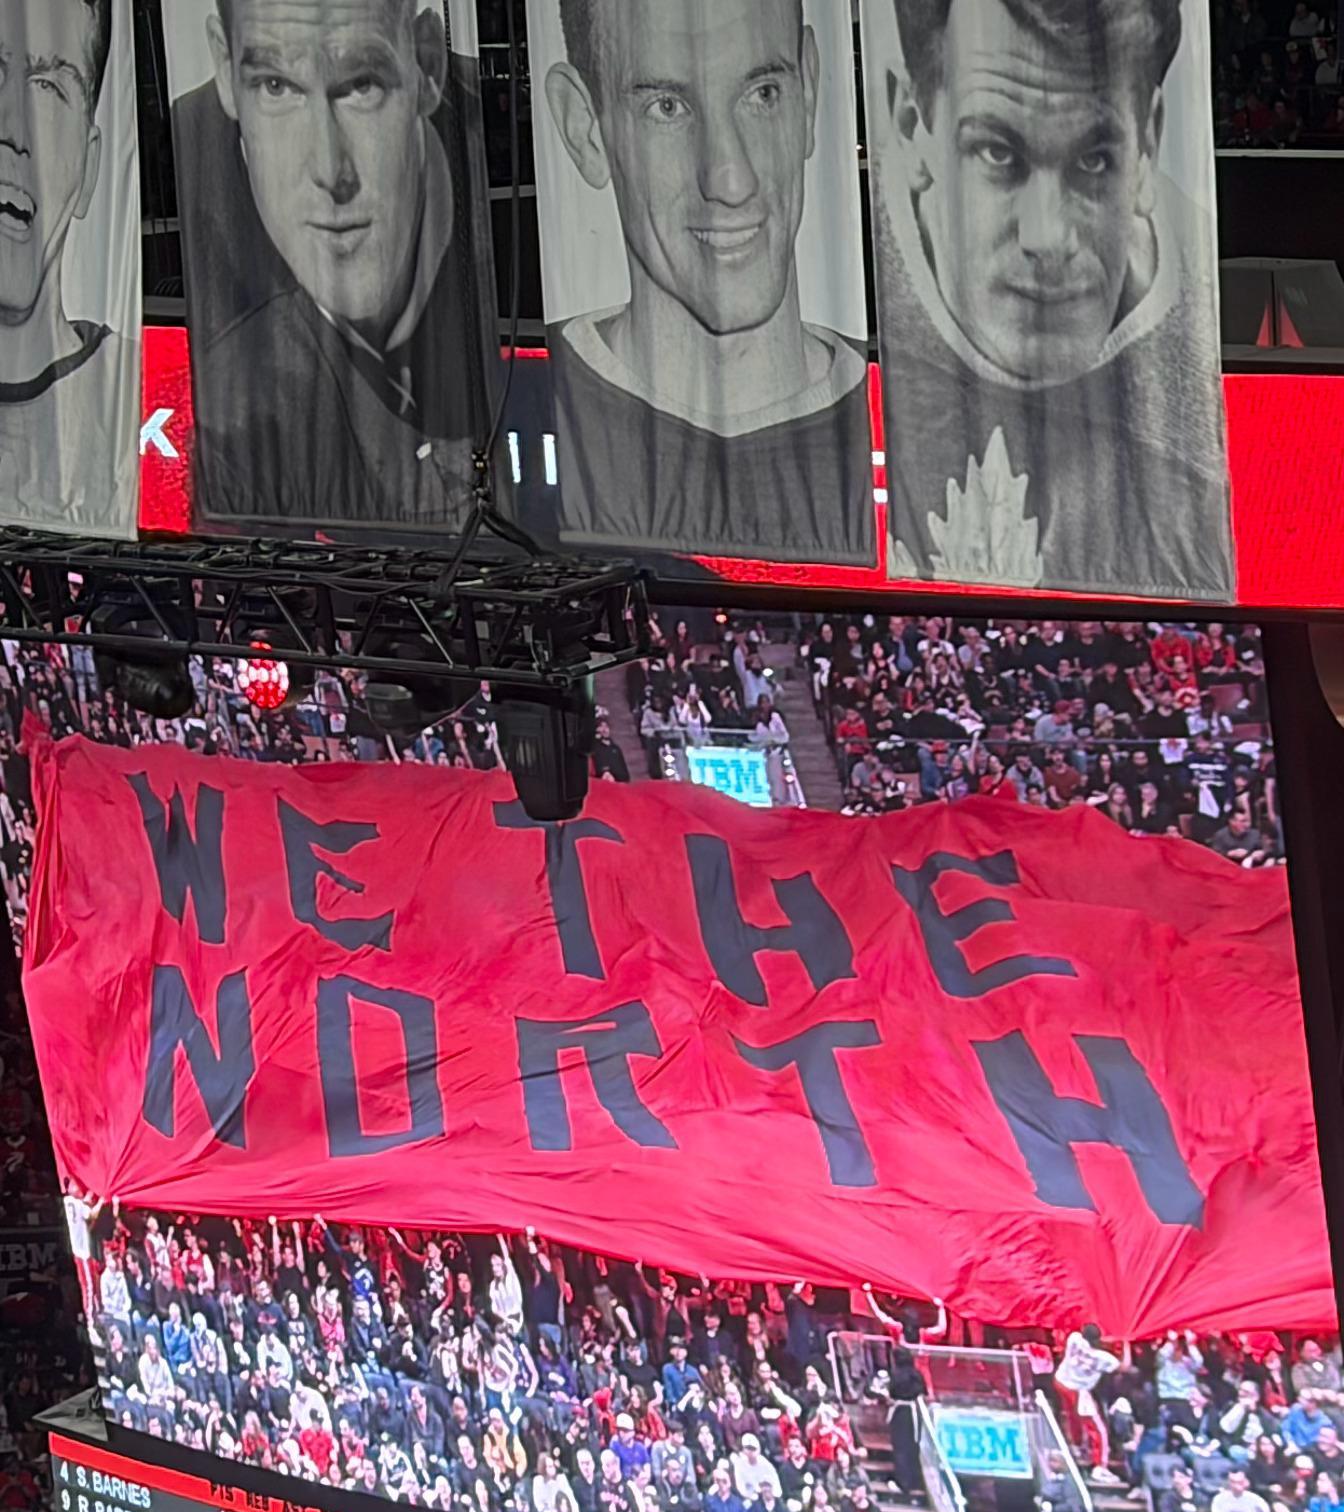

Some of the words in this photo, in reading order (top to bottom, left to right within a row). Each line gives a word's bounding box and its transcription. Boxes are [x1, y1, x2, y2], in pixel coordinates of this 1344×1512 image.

[127, 772, 394, 951] WE
[492, 798, 1079, 1008] THE
[142, 964, 1205, 1228] NORTH
[943, 1423, 1022, 1463] IBM
[60, 1462, 69, 1482] 4
[77, 1467, 90, 1489] S.
[93, 1471, 151, 1508] BARNES
[62, 1489, 71, 1511] 9
